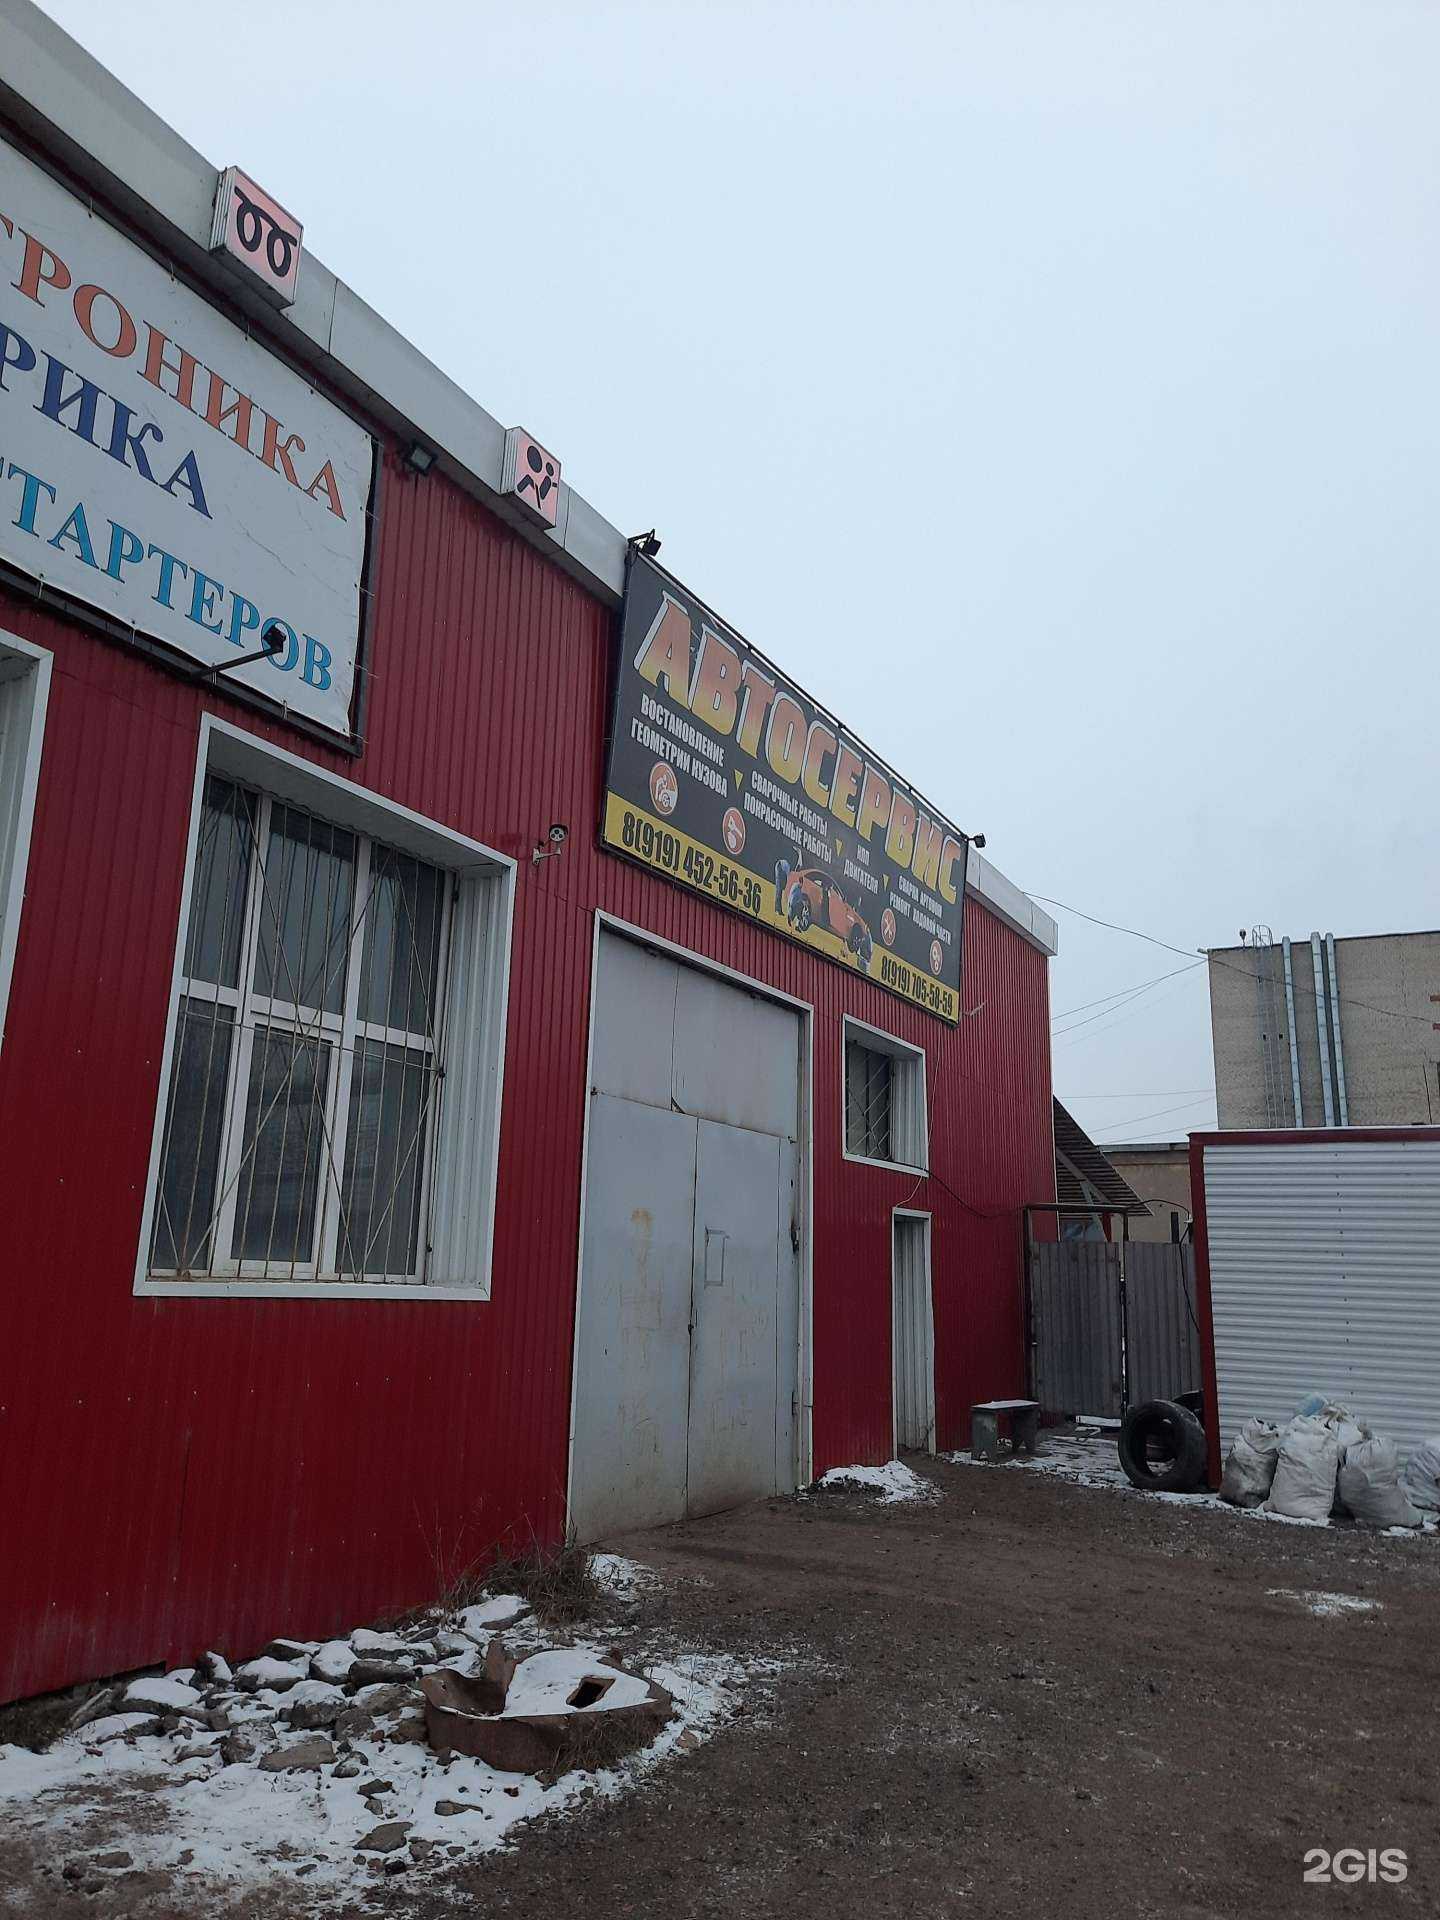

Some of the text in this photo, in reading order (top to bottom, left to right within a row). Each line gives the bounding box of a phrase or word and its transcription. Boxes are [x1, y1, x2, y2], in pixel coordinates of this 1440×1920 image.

[0, 457, 332, 691] ТАРТЕРОВ
[631, 717, 728, 798] ГЕОМЕТРИИ КУЗОВА
[633, 591, 961, 905] АВТОСЕРВИС
[641, 692, 725, 767] ВОСТАНОВЛЕНИЕ
[744, 792, 832, 864] ПОКРАСОЧНЫЕ РАБОТЫ
[751, 770, 828, 837] СВАРОЧНЫЕ РАБОТЫ
[622, 811, 762, 914] 8(919) 452-56-36
[843, 858, 879, 895] ДВИГАТЕЛЯ
[881, 956, 910, 993] 8(919)
